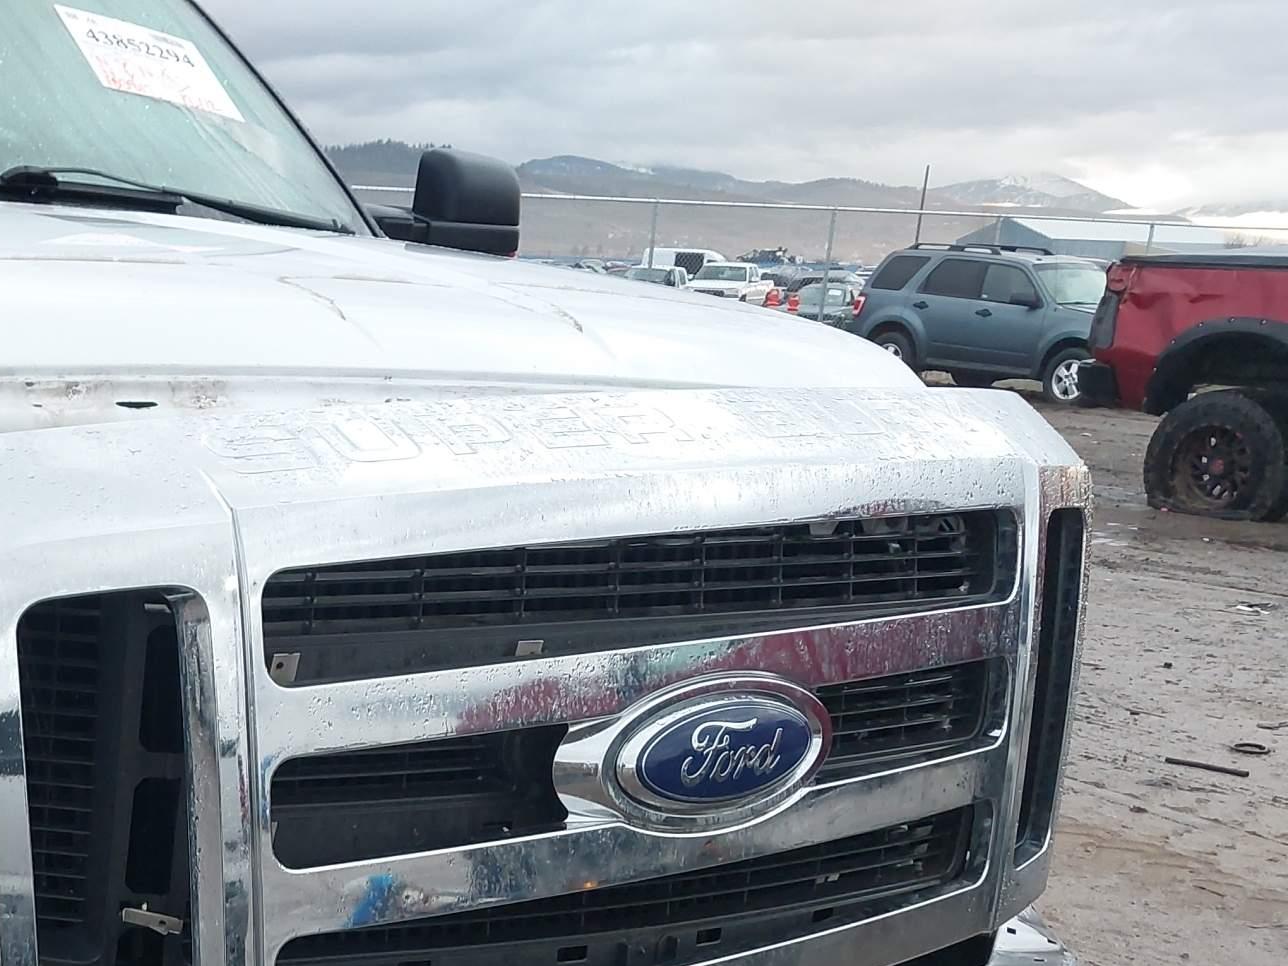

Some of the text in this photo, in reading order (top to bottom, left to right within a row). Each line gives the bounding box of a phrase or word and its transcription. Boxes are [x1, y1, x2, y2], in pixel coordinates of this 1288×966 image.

[85, 28, 195, 68] 43852294
[200, 402, 695, 474] SUPER
[680, 717, 783, 787] Ford
